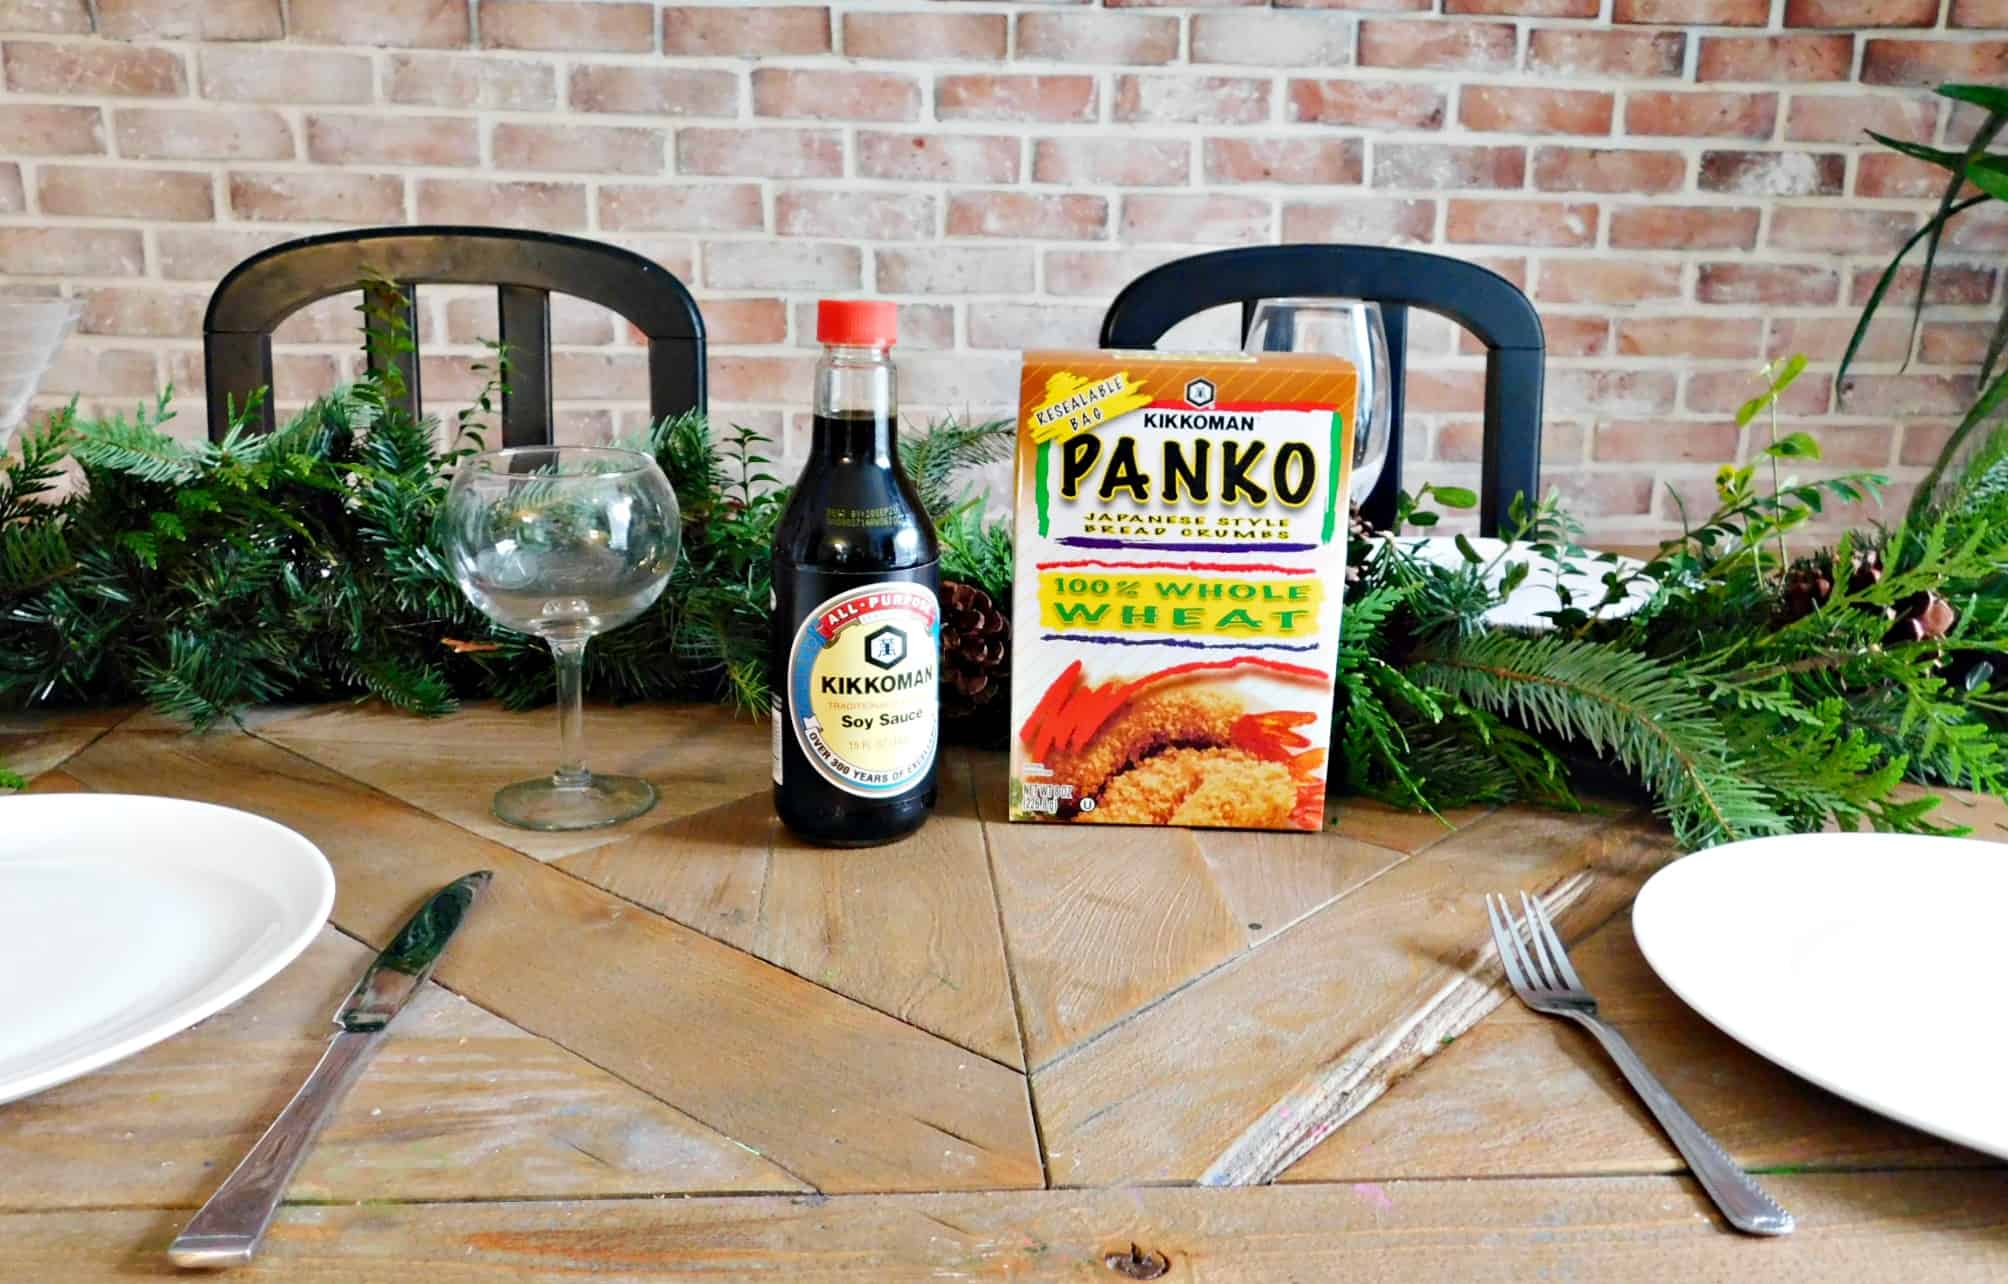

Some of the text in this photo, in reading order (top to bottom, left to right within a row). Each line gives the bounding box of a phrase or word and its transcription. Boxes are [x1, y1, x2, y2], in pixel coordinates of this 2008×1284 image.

[1036, 376, 1123, 425] RESEALABLE
[1070, 407, 1101, 431] BAG
[1143, 412, 1254, 431] KIKKOMAN
[1060, 432, 1316, 507] PANKO
[1084, 512, 1290, 527] JAPANESE STYLE
[1084, 524, 1290, 539] BREAD CRUMBS
[1054, 577, 1313, 600] 100% WHOLE
[1053, 602, 1310, 629] WHEAT
[821, 664, 933, 695] KIKKOMAN
[841, 708, 923, 730] Soy Sauce
[809, 732, 831, 760] OVER
[831, 758, 850, 775] 300
[853, 770, 889, 783] YEARS
